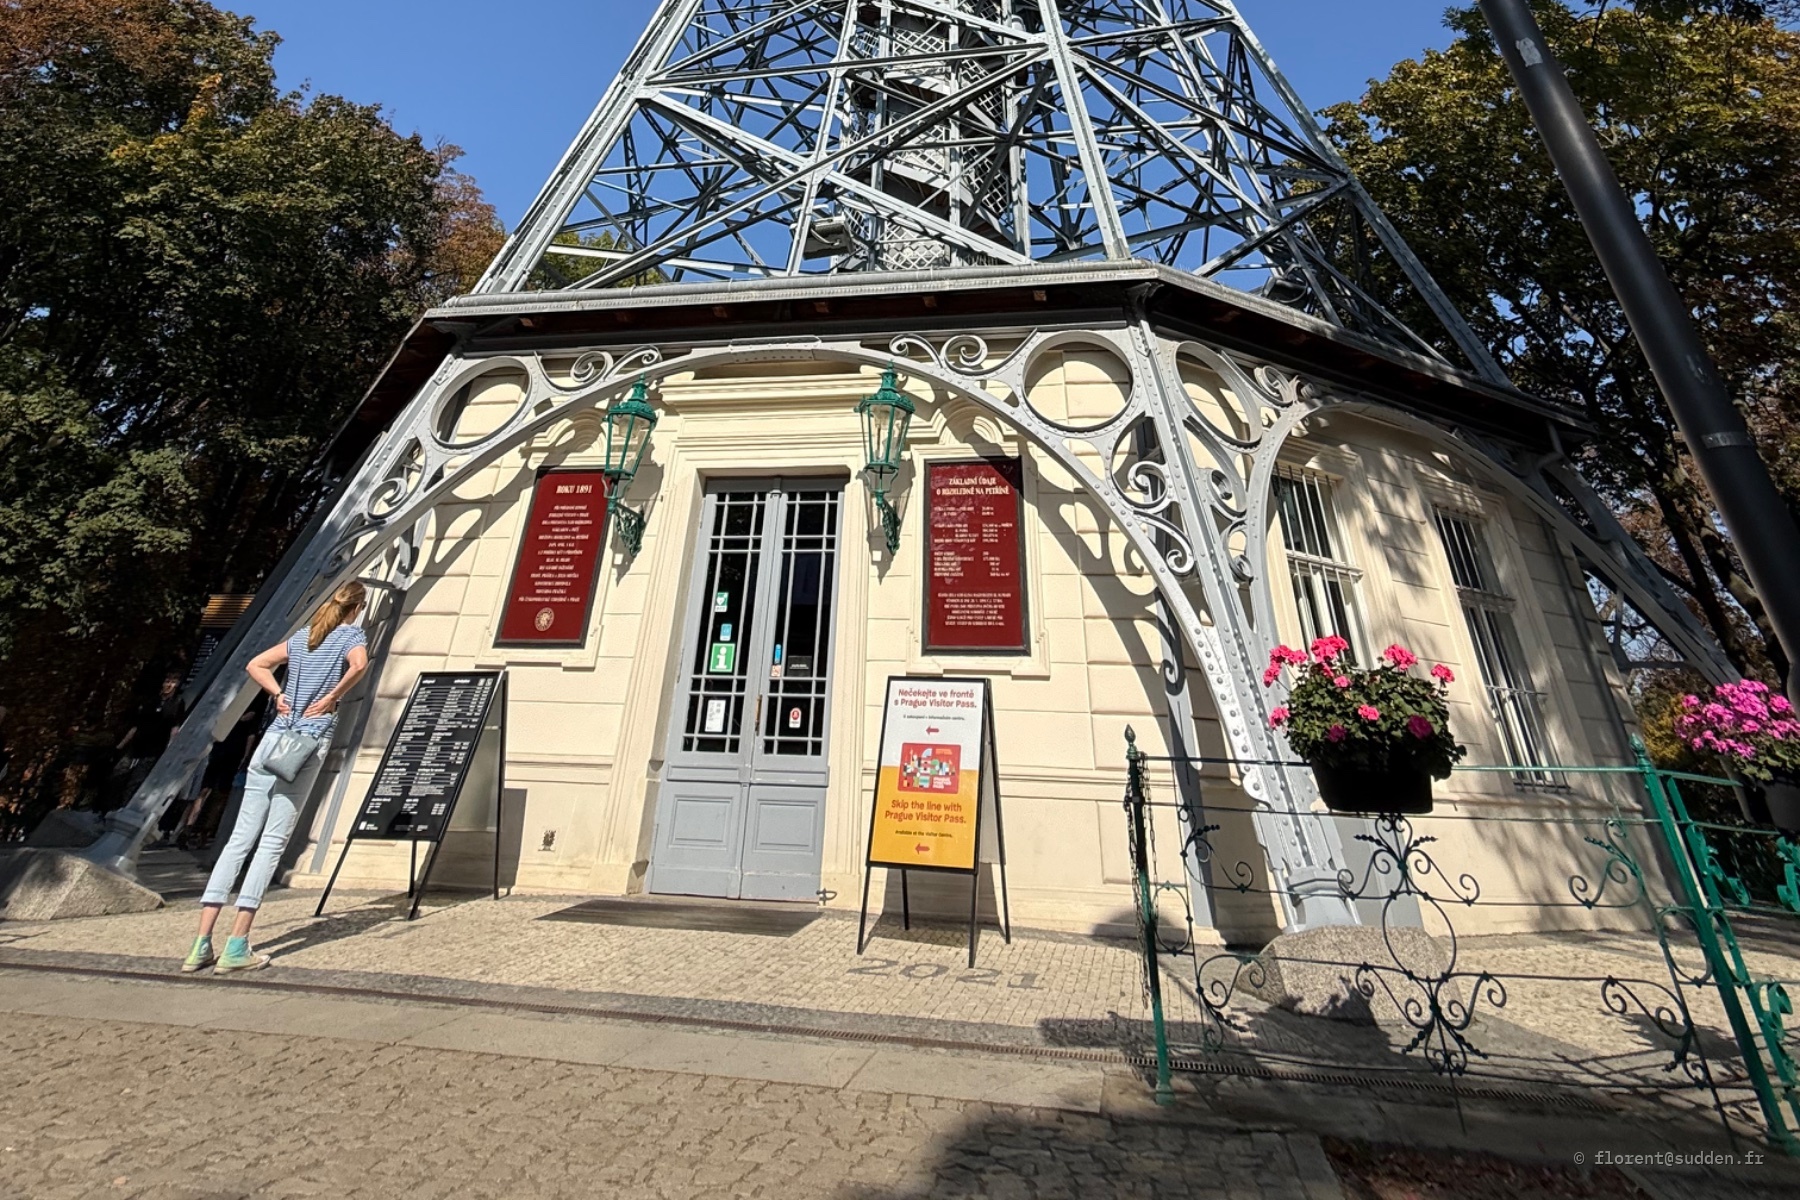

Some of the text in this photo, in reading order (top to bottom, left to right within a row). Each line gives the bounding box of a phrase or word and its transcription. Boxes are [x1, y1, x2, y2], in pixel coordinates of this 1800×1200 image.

[556, 484, 593, 494] ROKU 1891
[898, 688, 937, 699] Nečekejte
[950, 689, 974, 698] frontě
[900, 698, 927, 708] Prague
[929, 699, 954, 707] Visitor
[956, 700, 977, 708] Pass.
[891, 799, 962, 812] Skip the line with
[885, 810, 966, 824] Prague Visitor Pass.
[846, 958, 1046, 990] 2021
